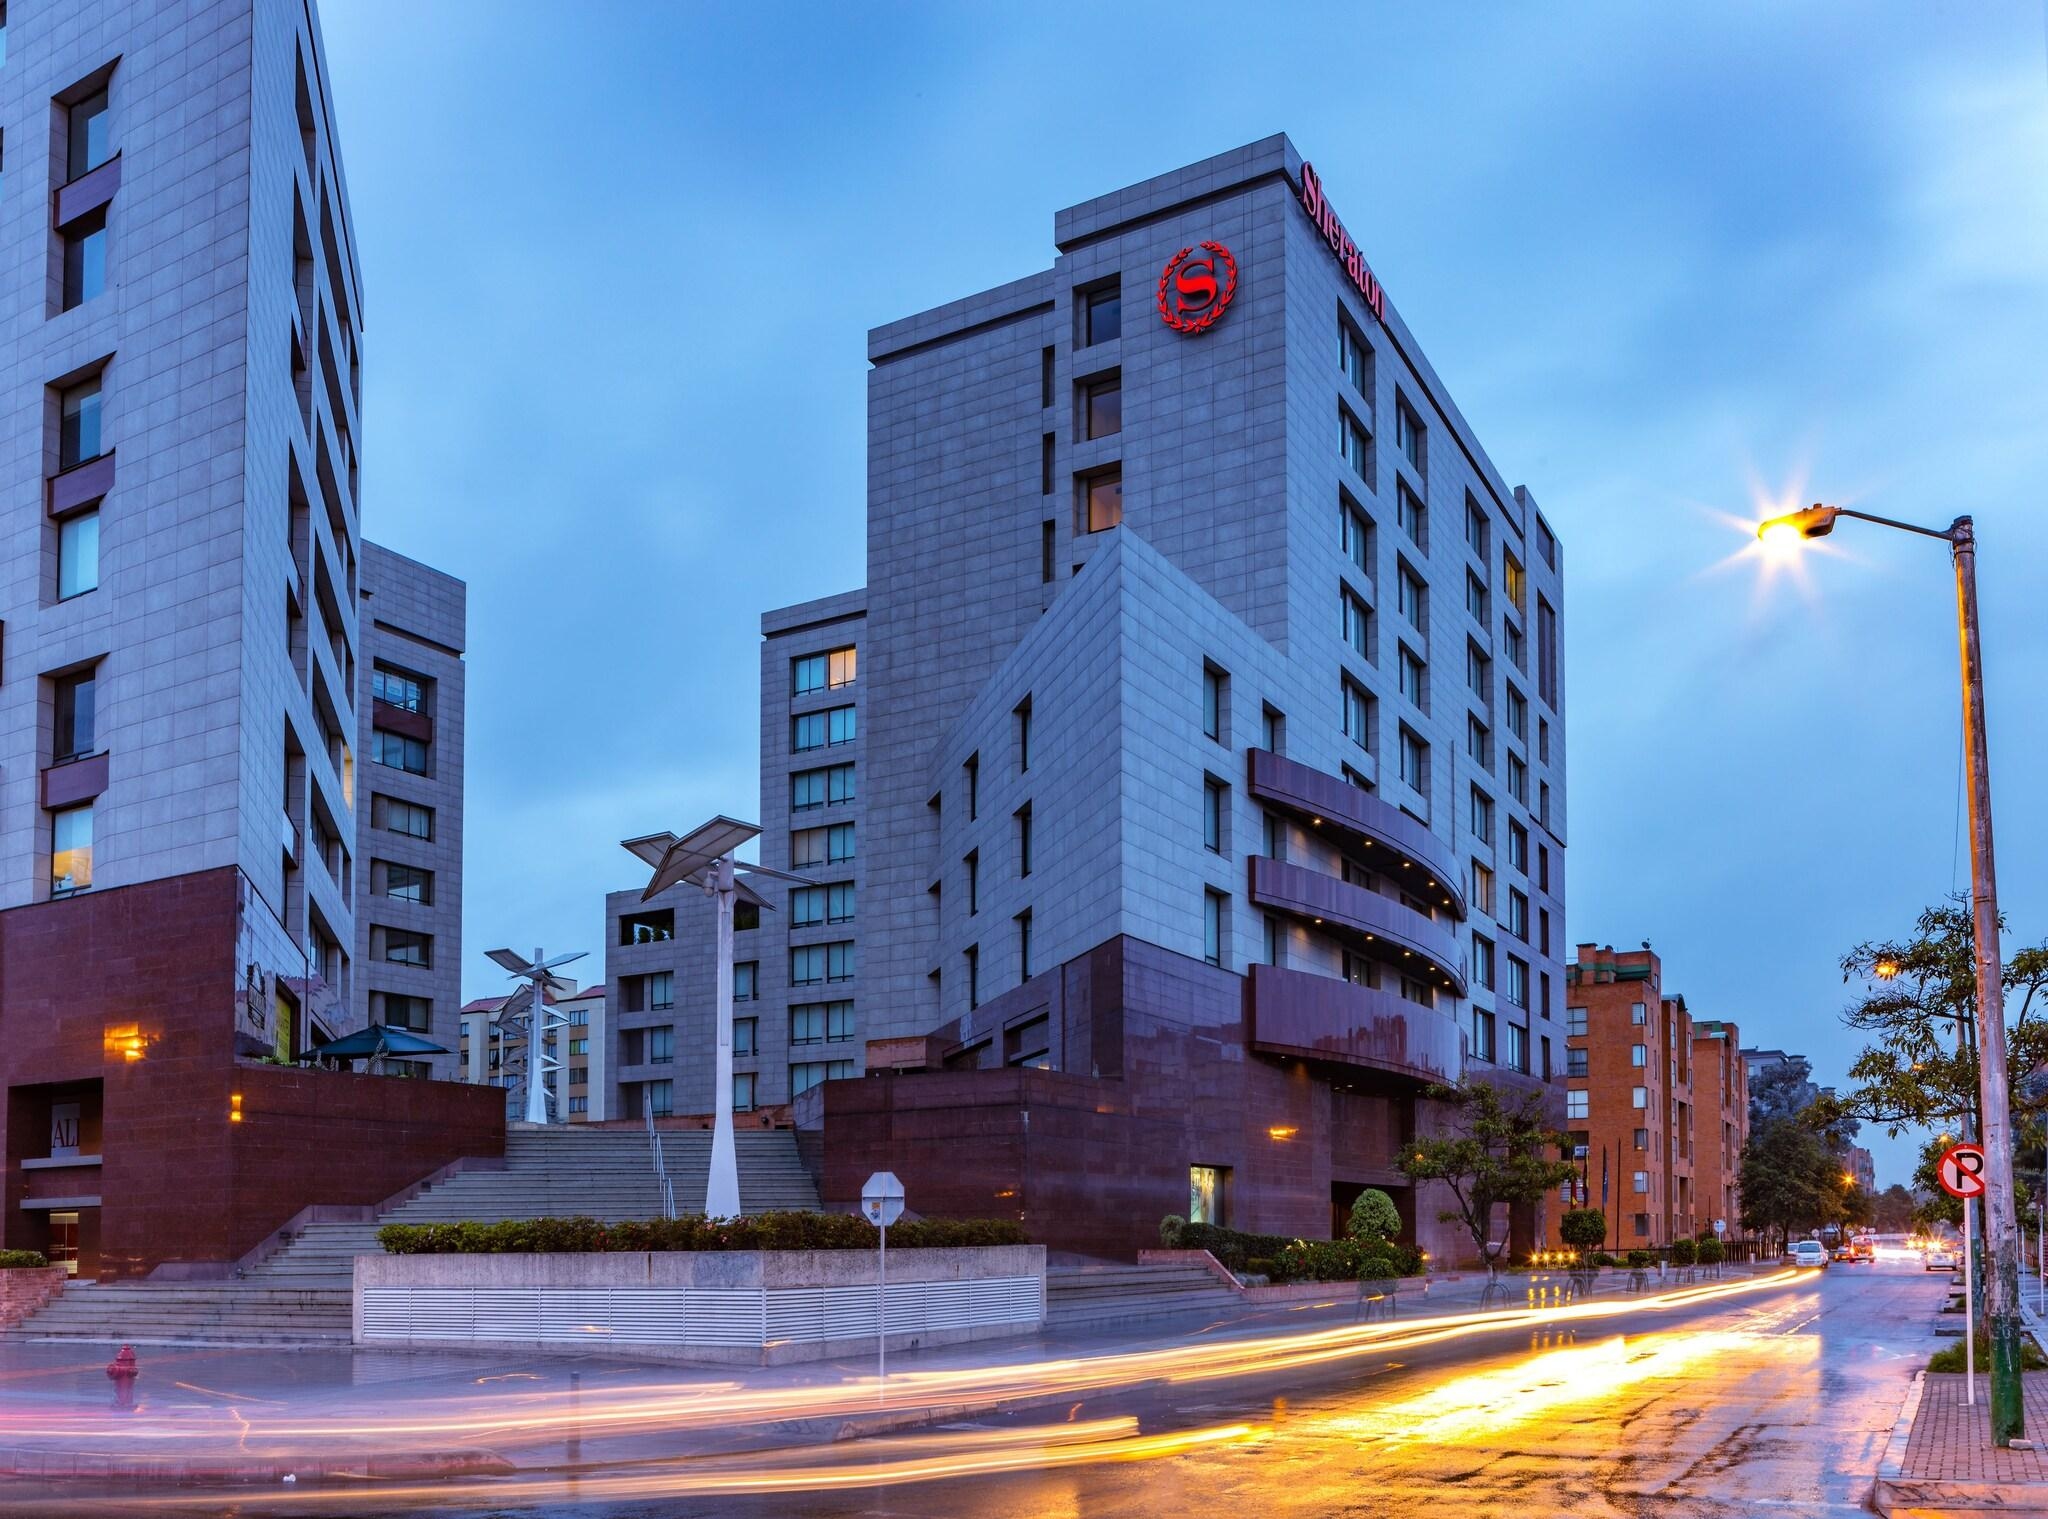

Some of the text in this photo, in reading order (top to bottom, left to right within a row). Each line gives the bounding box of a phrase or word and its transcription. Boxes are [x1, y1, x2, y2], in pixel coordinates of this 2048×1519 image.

[1301, 161, 1385, 324] Sheraton
[1176, 257, 1219, 315] S
[1956, 1152, 1984, 1190] P
